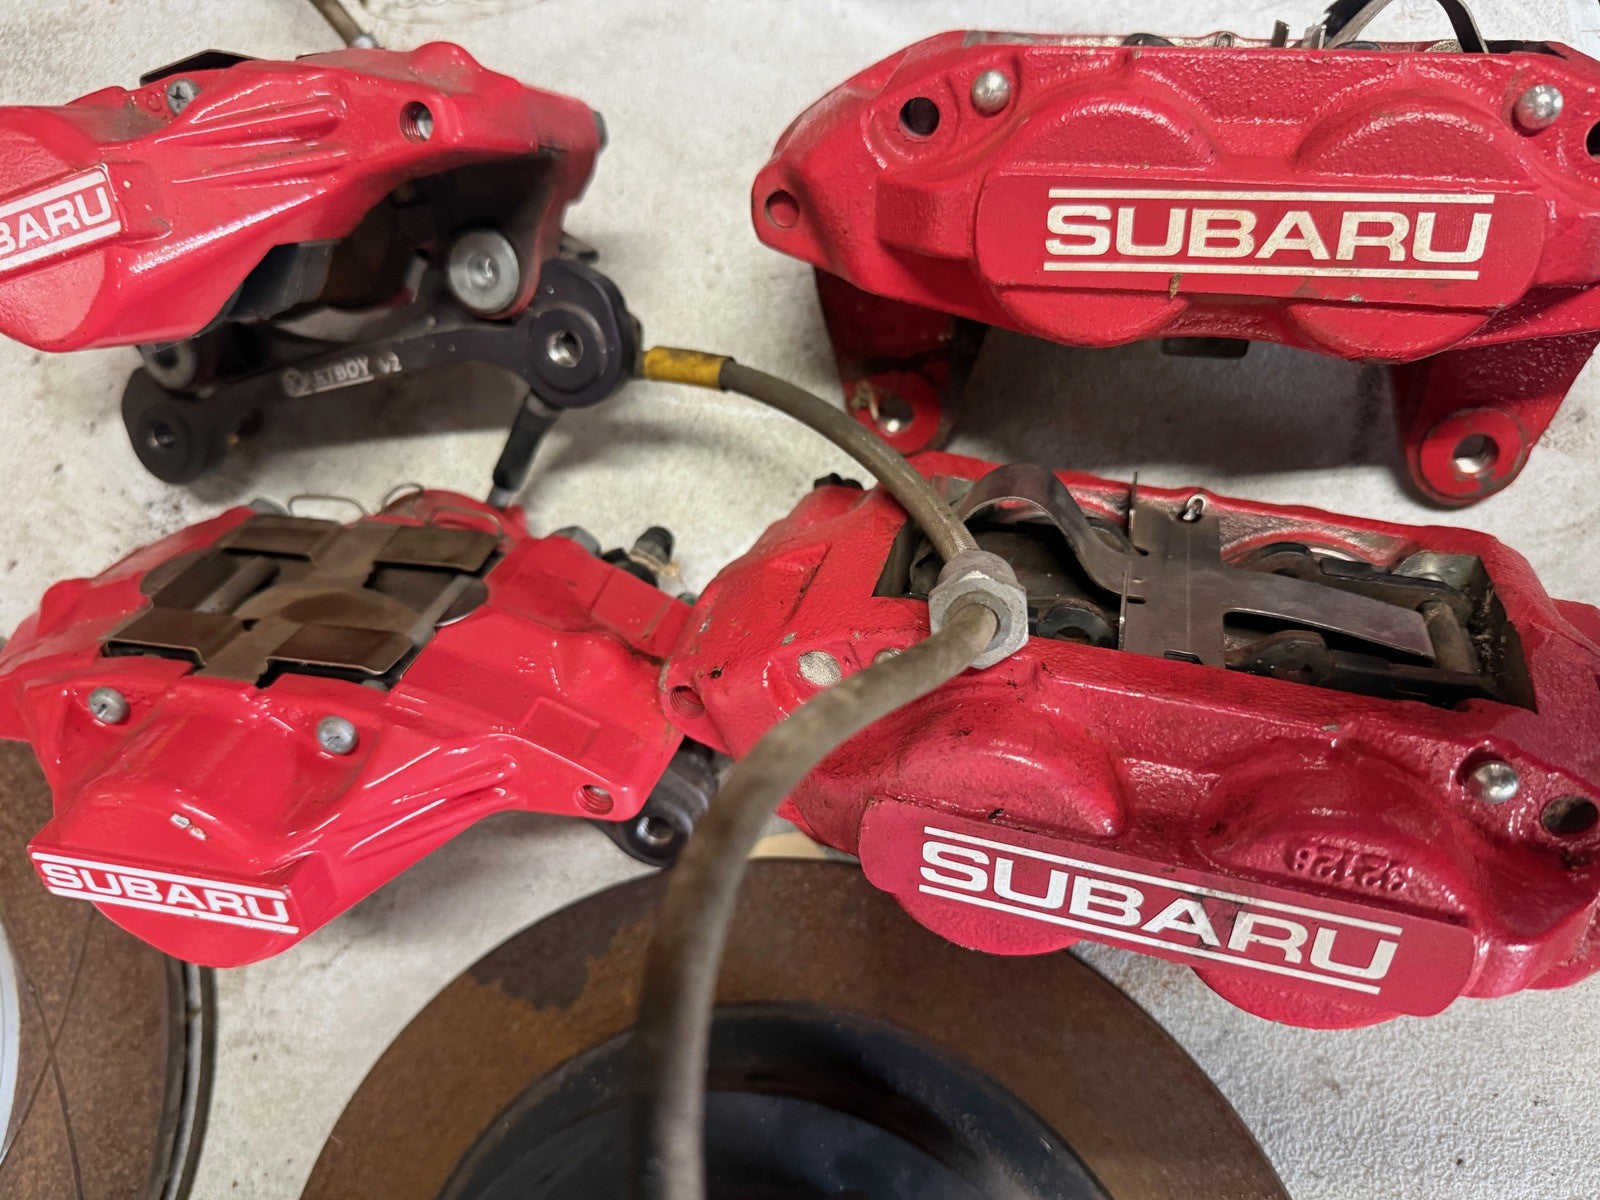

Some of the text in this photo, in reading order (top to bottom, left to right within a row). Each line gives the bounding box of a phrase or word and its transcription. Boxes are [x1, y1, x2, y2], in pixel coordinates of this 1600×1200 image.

[1045, 205, 1492, 263] SUBARU
[41, 863, 290, 924] SUBARU
[919, 840, 1399, 980] SUBARU
